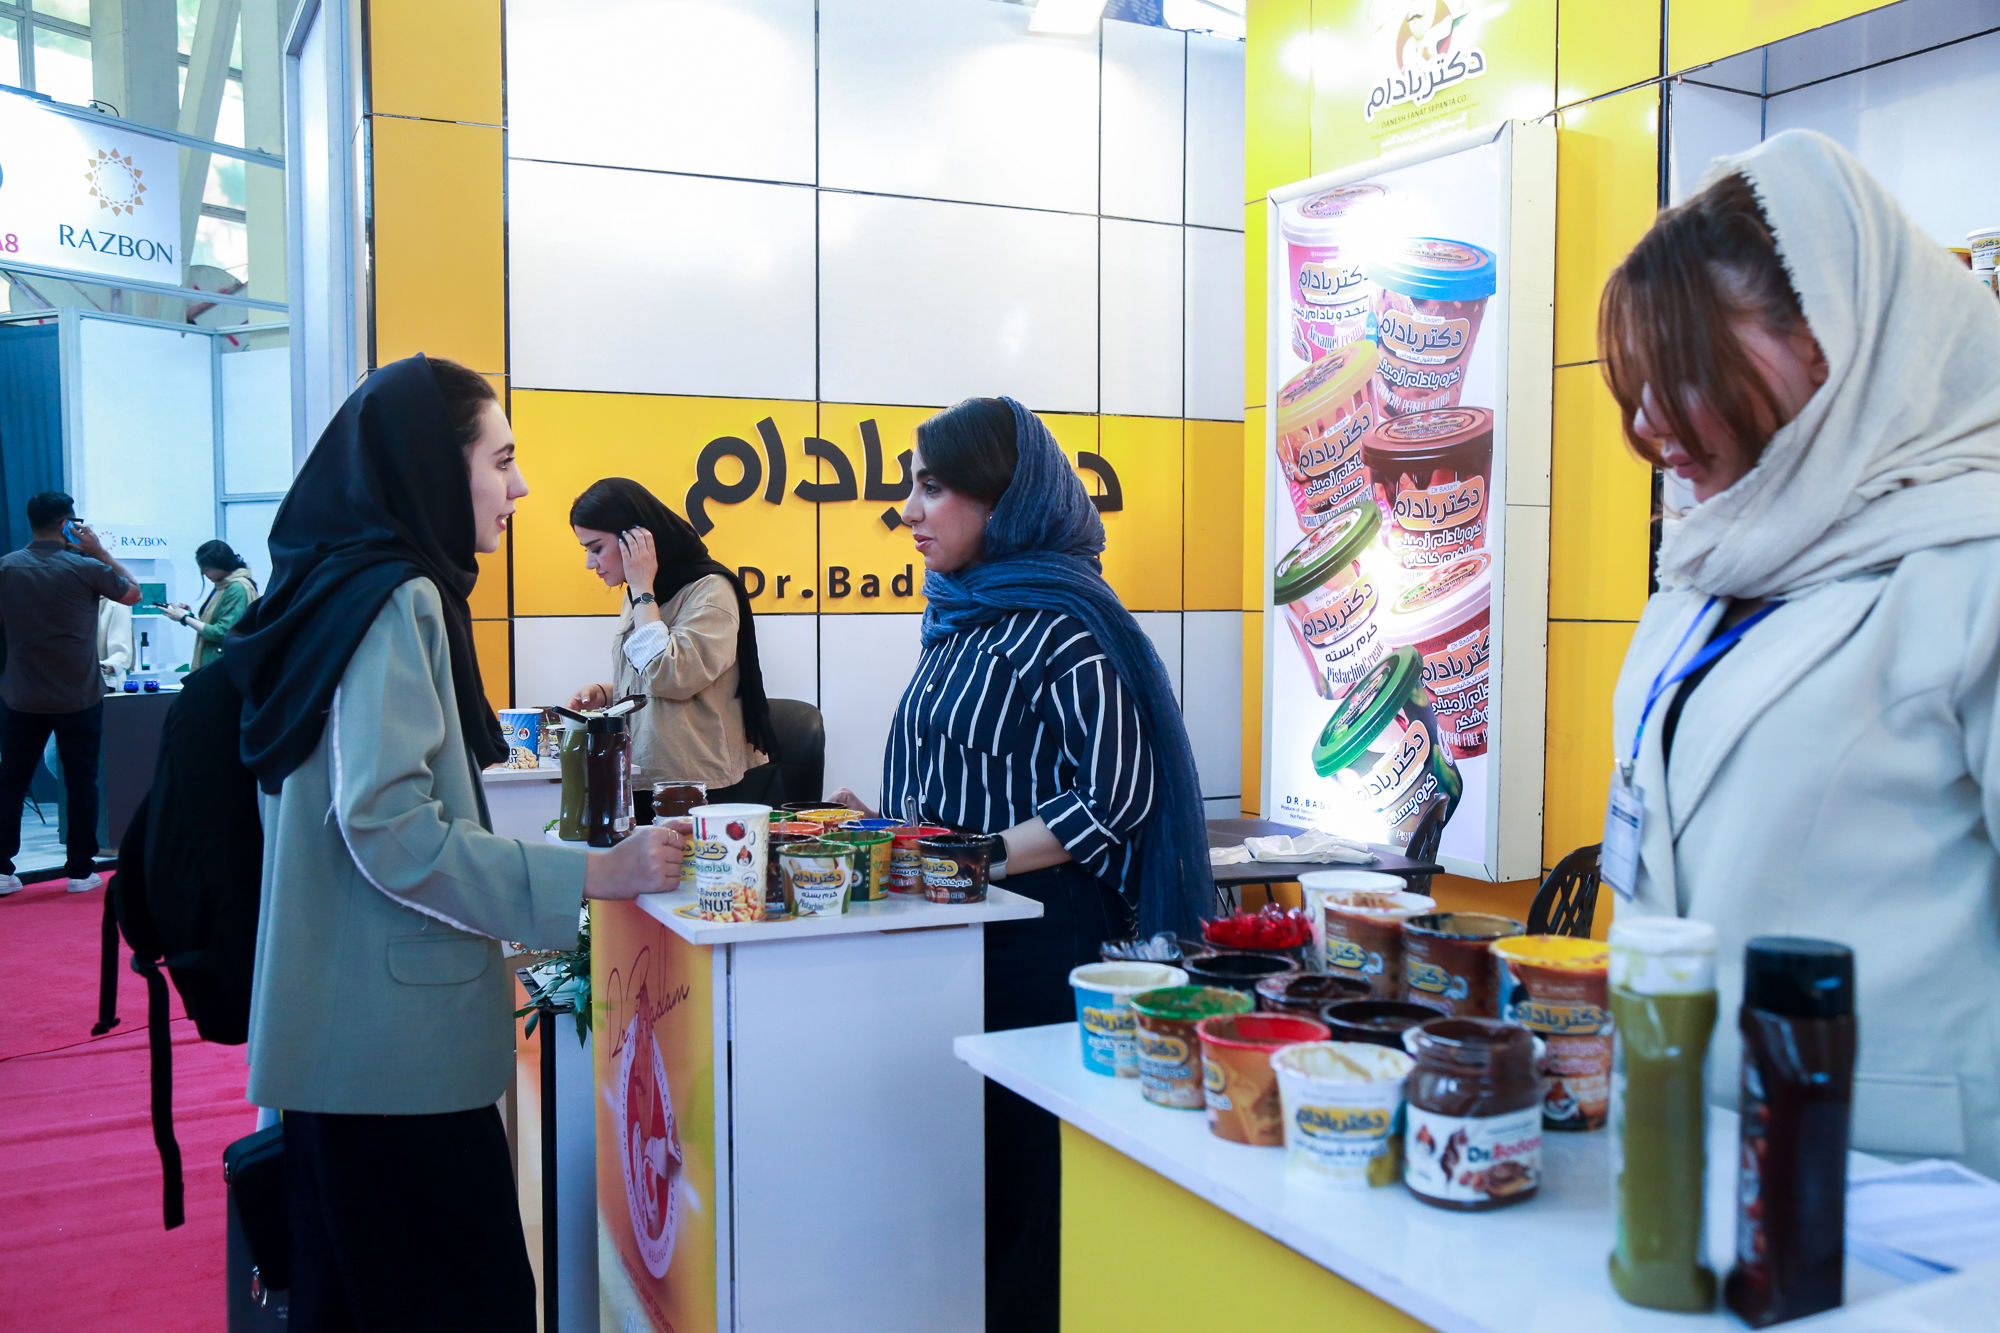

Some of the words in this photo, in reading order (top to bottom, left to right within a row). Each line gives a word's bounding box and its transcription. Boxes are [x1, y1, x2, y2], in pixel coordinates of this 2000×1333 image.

[60, 224, 173, 264] RAZBON
[1330, 477, 1364, 504] عسلی
[121, 536, 168, 547] RAZBON
[737, 564, 914, 599] Dr.Bad
[1356, 623, 1378, 651] کرم
[1325, 643, 1356, 662] پسته
[1457, 709, 1483, 731] شکر
[699, 899, 733, 912] ANUT
